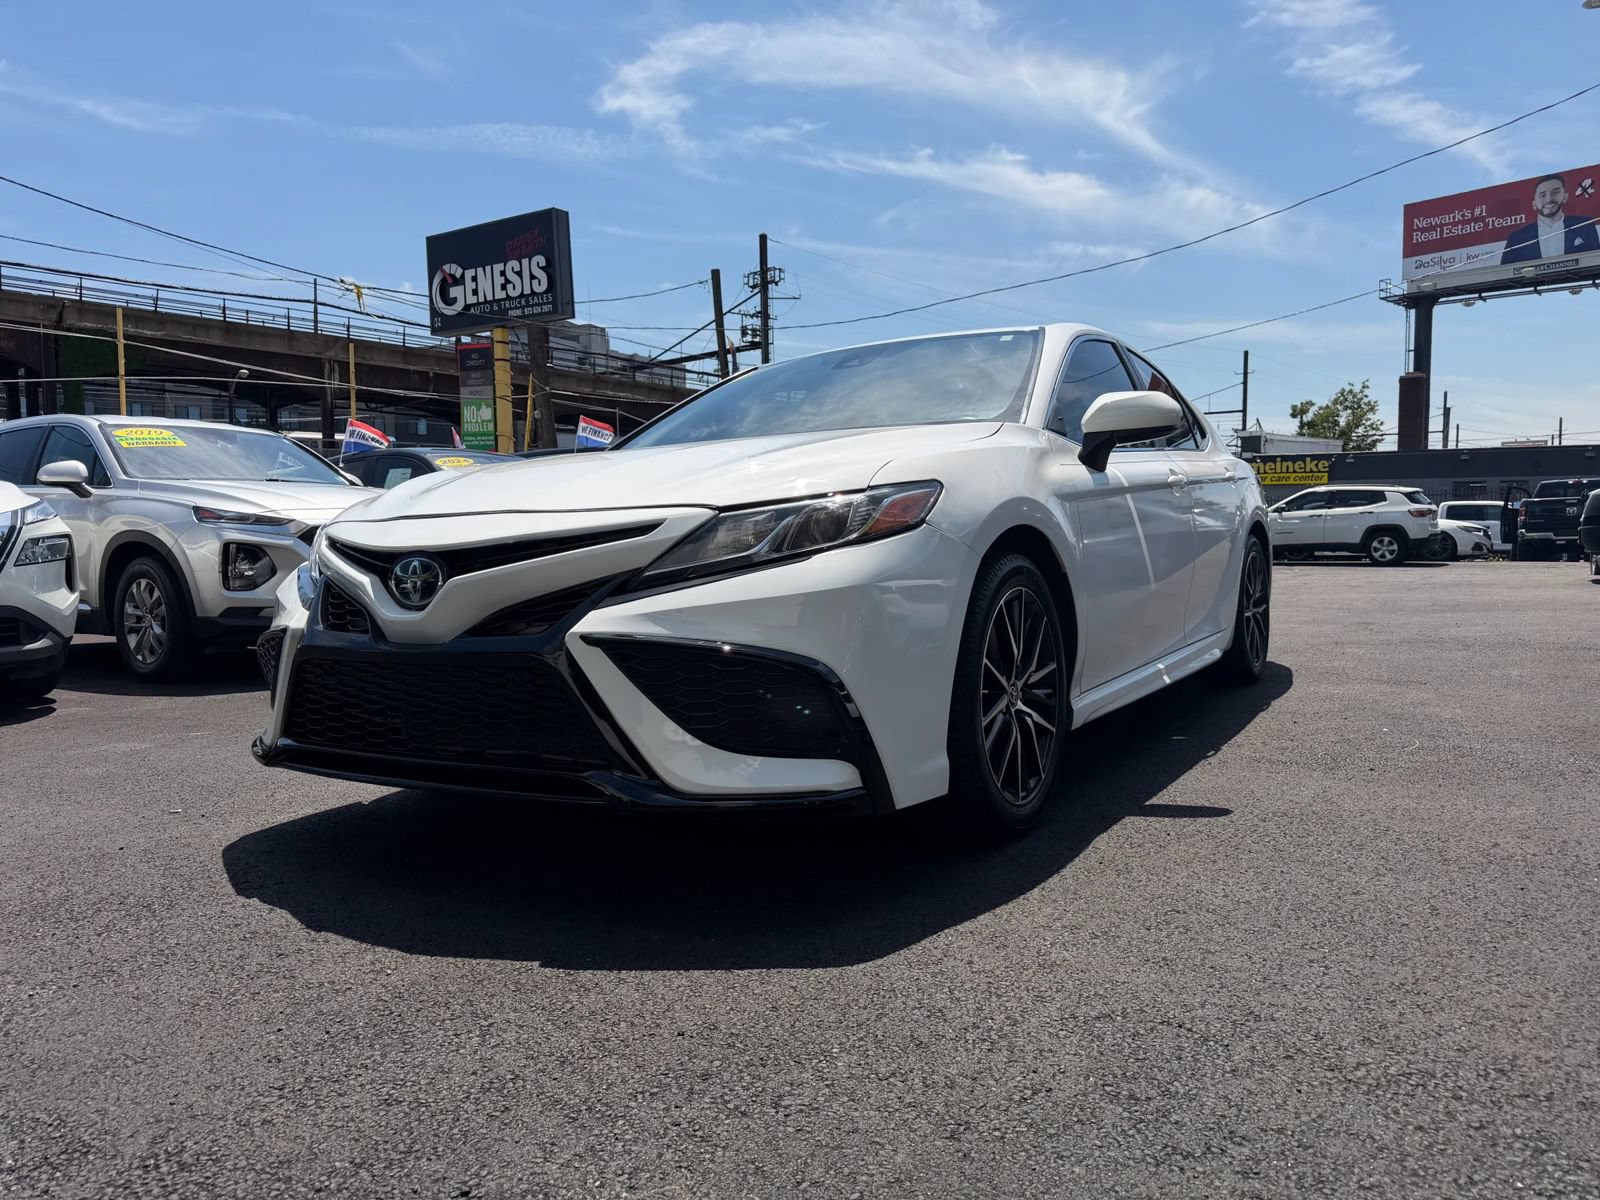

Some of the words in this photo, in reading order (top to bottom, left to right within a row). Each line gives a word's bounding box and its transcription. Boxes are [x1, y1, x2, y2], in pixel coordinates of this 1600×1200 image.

[1413, 208, 1471, 229] Newark's
[1473, 205, 1487, 217] #1
[1412, 227, 1440, 243] Real
[1443, 221, 1484, 237] Estate
[1485, 214, 1526, 229] Team
[1414, 255, 1456, 270] DaSilva
[432, 254, 548, 316] GENESIS
[470, 303, 491, 314] AUTO
[493, 302, 499, 311] &
[501, 297, 527, 309] TRUCK
[529, 293, 553, 305] SALES
[463, 406, 477, 422] NO
[464, 423, 494, 432] PROBLEM
[1270, 474, 1291, 482] care
[1293, 473, 1325, 482] center
